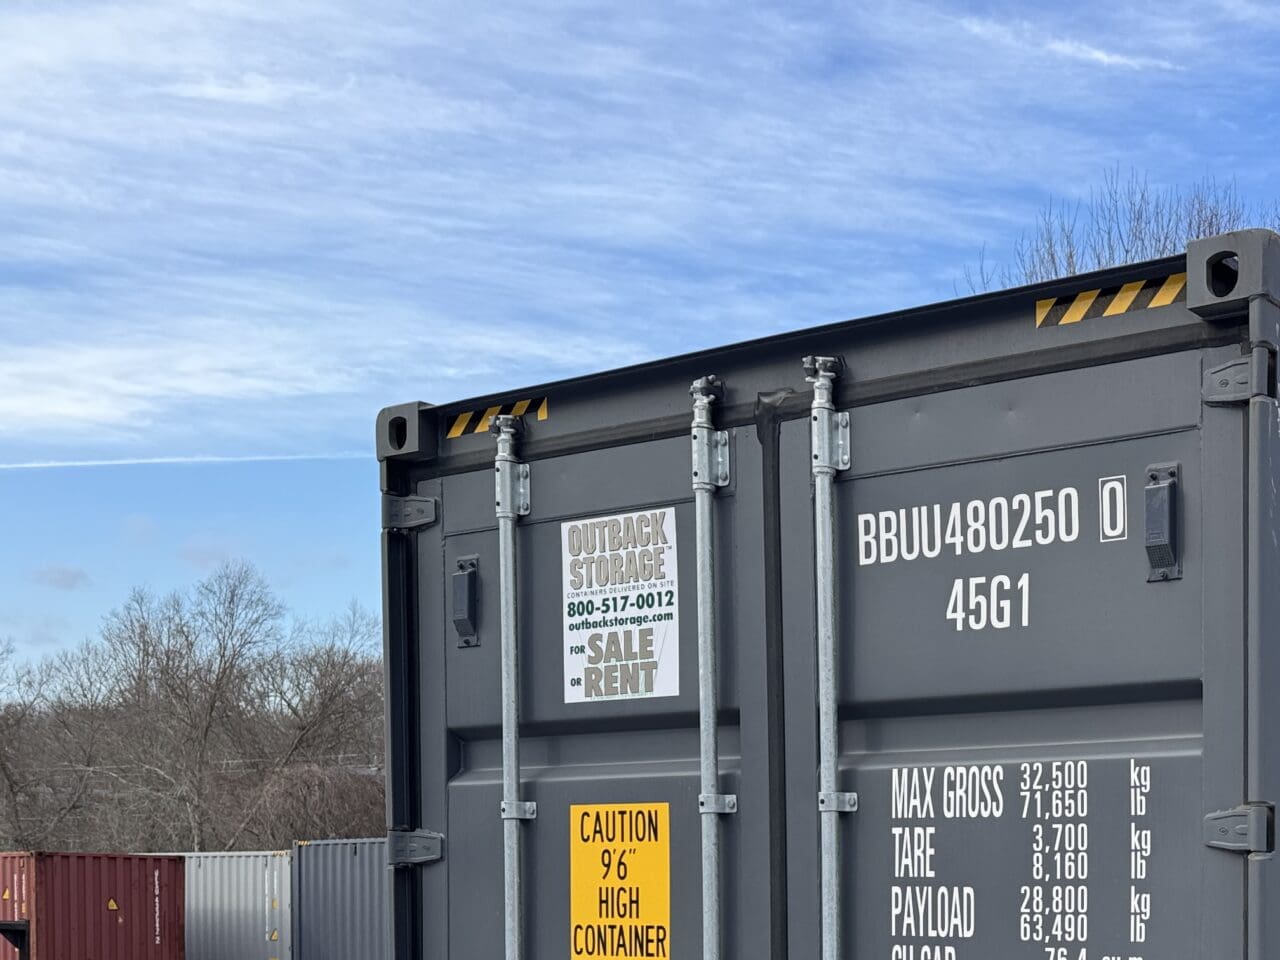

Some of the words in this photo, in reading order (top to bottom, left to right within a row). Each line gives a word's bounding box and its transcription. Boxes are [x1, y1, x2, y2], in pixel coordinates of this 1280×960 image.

[1101, 480, 1125, 537] 0
[567, 511, 669, 556] OUTBACK
[569, 547, 666, 590] STORAGE
[567, 588, 607, 599] CONTAINERS
[609, 583, 645, 593] DELIVERED
[567, 590, 674, 617] 800-517-0012
[946, 573, 1030, 631] 45G1
[568, 612, 674, 631] outbackstorage.com
[570, 646, 585, 655] FOR
[587, 627, 654, 665] SALE
[570, 678, 582, 687] OR
[584, 661, 658, 698] RENT
[891, 767, 936, 819] MAX
[943, 765, 1004, 819] GROSS
[1020, 760, 1088, 791] 32,500
[1130, 758, 1151, 793] kg
[1020, 789, 1088, 820] 71,650
[1130, 788, 1146, 816] lb
[580, 809, 659, 843] CAUTION
[891, 826, 936, 878] TARE
[1032, 823, 1088, 853] 3,700
[1130, 823, 1151, 856] kg
[1032, 852, 1088, 882] 8,160
[1130, 852, 1147, 880] lb
[598, 886, 640, 919] HIGH
[891, 886, 975, 938] PAYLOAD
[1020, 886, 1088, 914] 28,800
[1130, 885, 1151, 919] kg
[573, 924, 667, 958] CONTAINER
[1020, 914, 1088, 943] 63,490
[1130, 914, 1146, 943] lb
